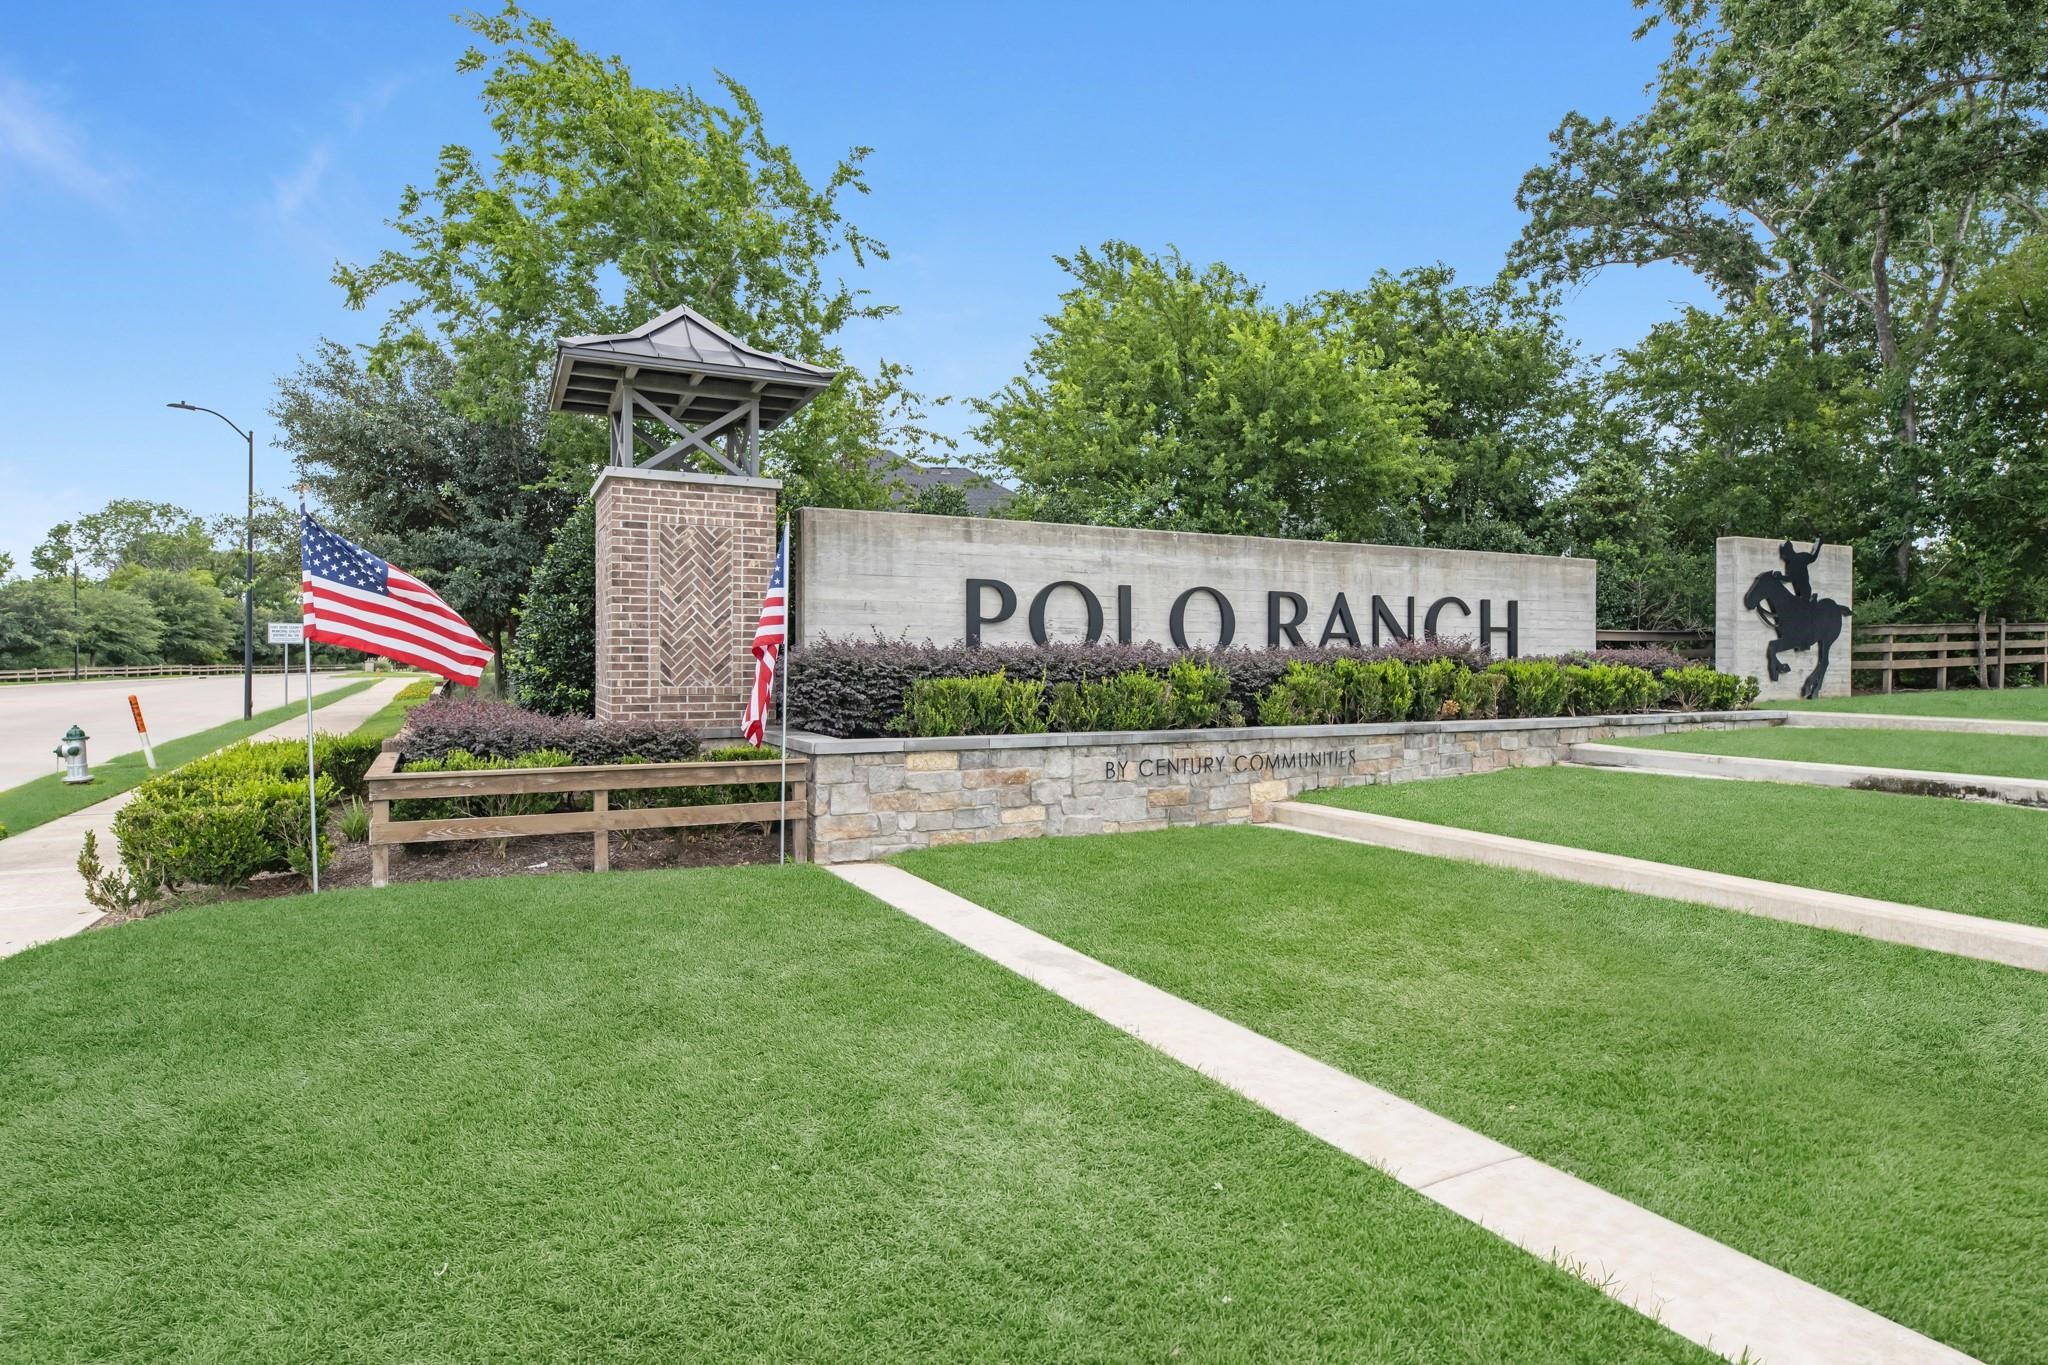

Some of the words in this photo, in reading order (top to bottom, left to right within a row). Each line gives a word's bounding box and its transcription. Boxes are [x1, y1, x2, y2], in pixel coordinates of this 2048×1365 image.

[966, 578, 1235, 649] POLO
[1268, 590, 1519, 658] RANCH
[1106, 760, 1128, 779] BY
[1139, 755, 1225, 777] CENTURY
[1235, 748, 1356, 772] COMMUNITIES
